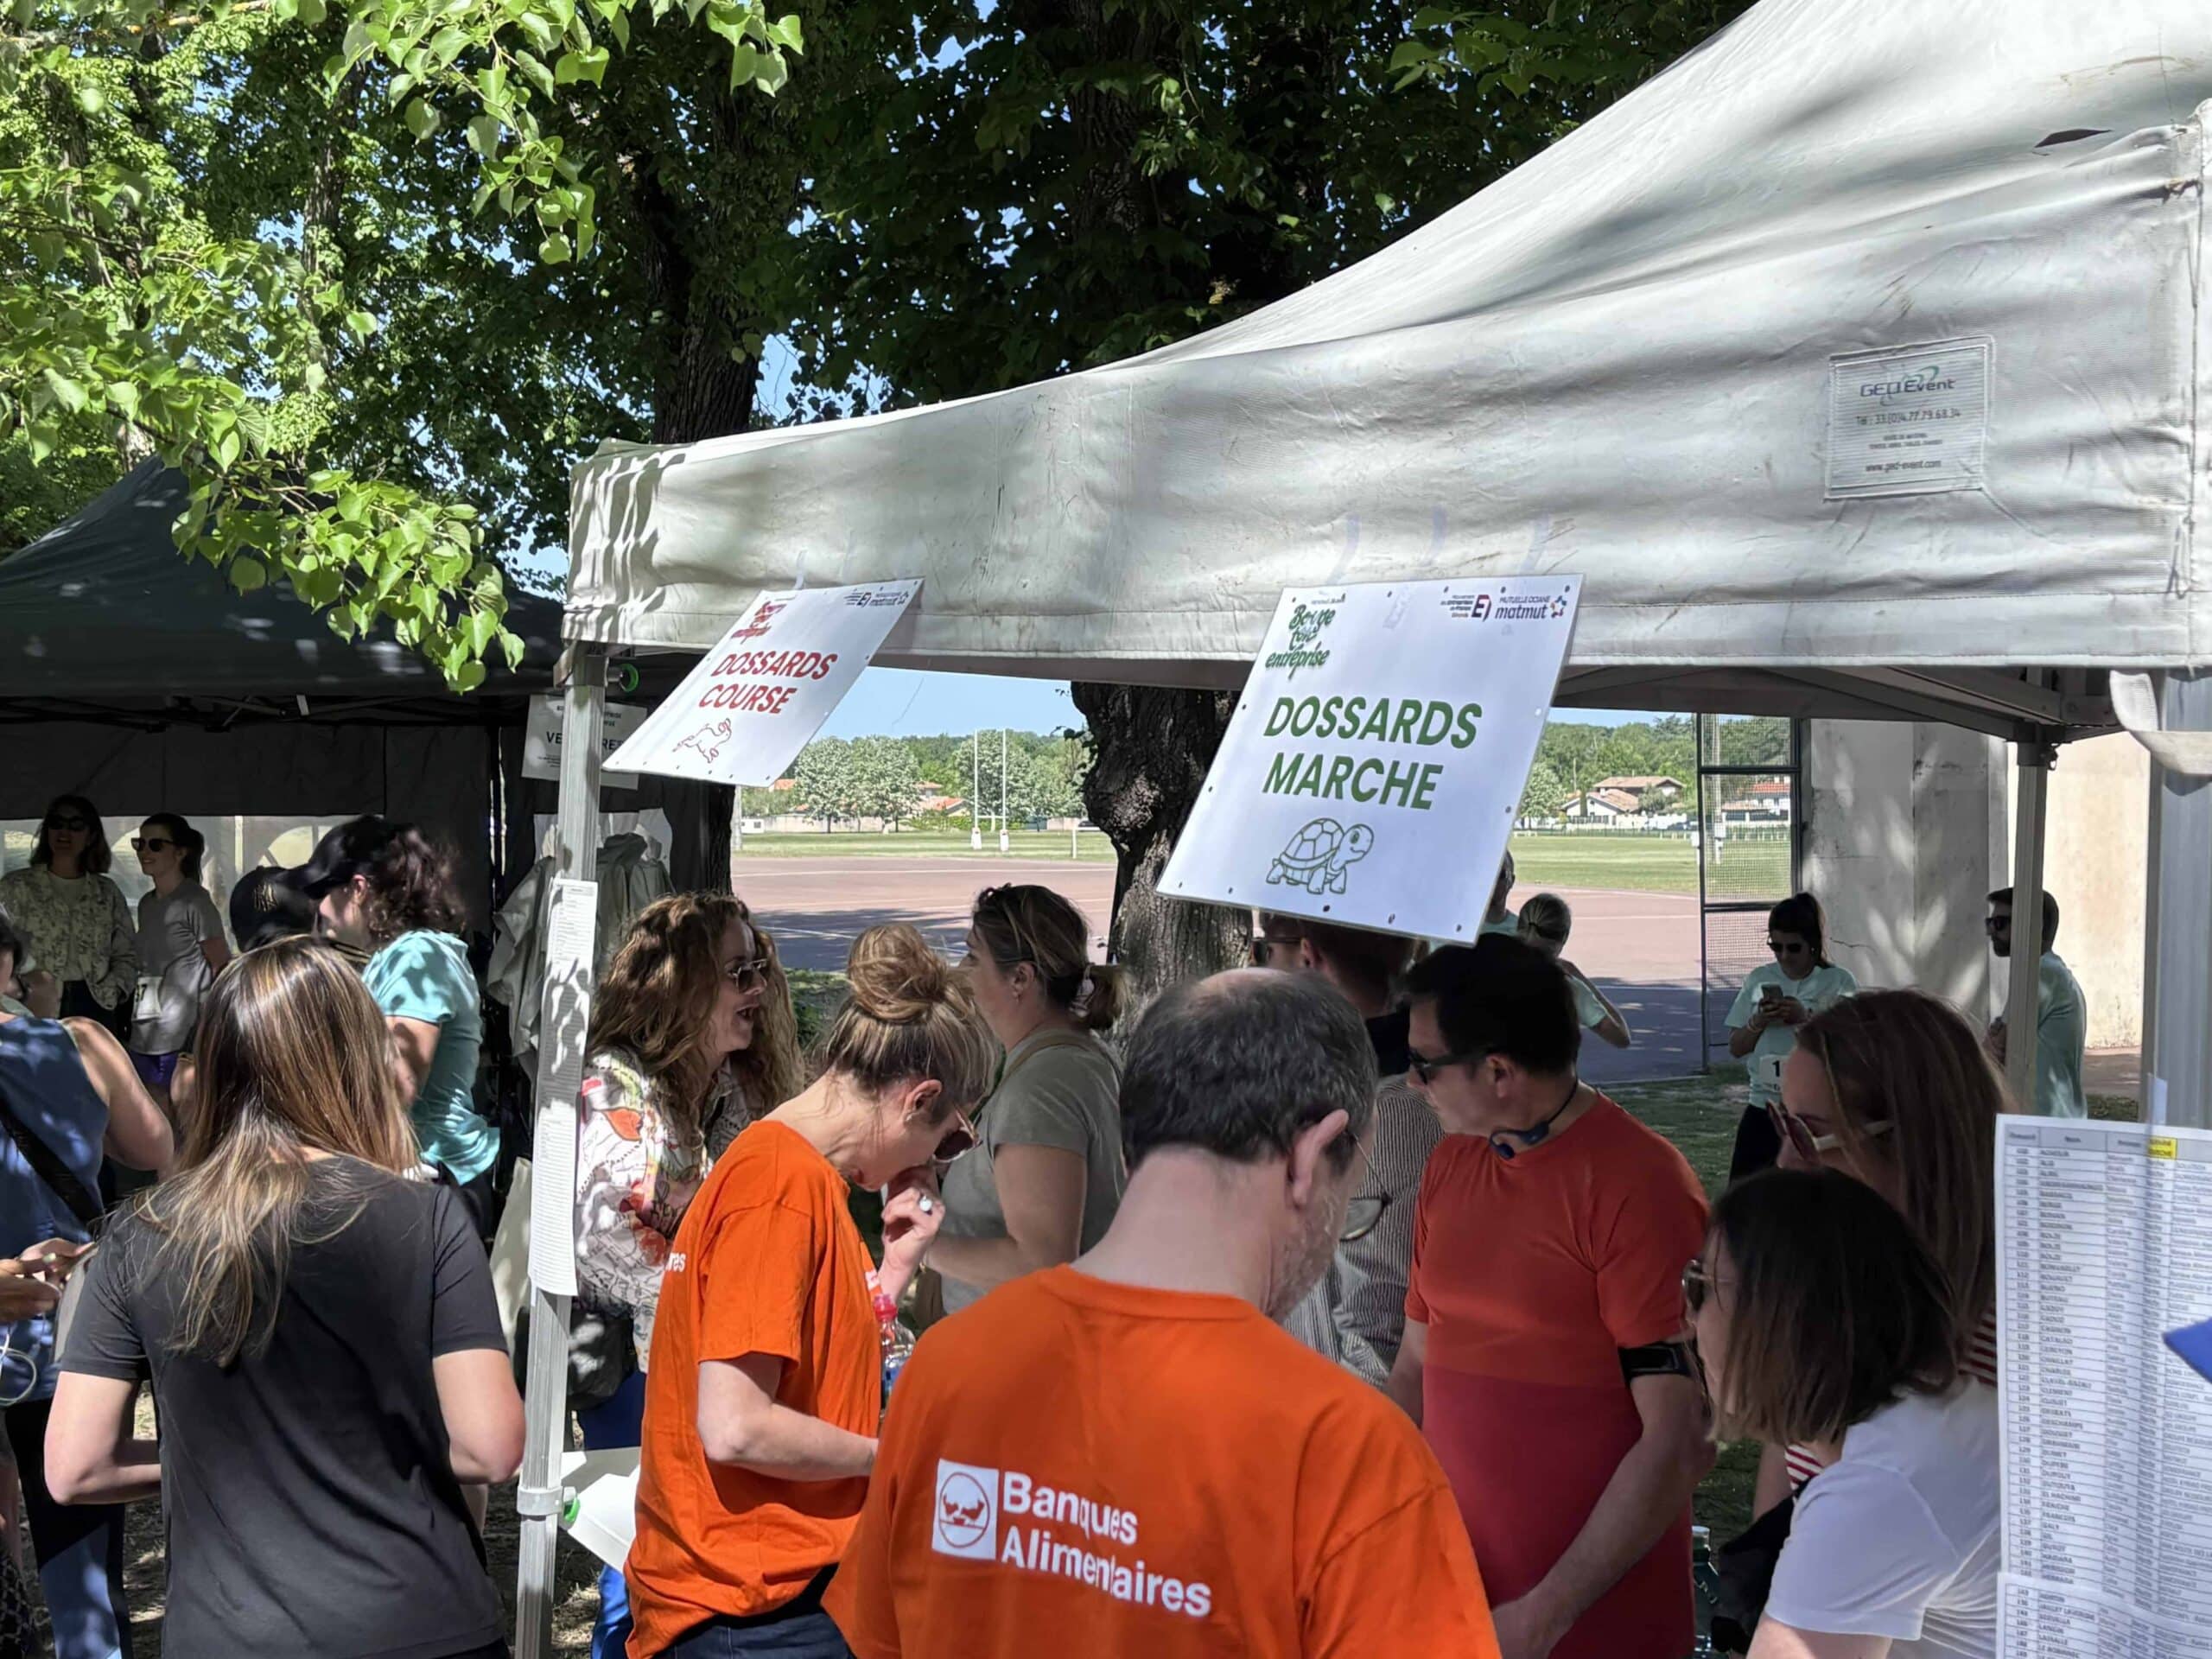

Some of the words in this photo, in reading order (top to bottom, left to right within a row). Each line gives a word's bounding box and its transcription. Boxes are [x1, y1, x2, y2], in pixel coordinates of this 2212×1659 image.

[1495, 605, 1548, 620] matmut
[711, 651, 838, 680] DOSSARDS
[1265, 641, 1330, 680] entreprise
[699, 683, 798, 715] COURSE
[1263, 696, 1482, 749] DOSSARDS
[1262, 753, 1444, 810] MARCHE
[1003, 1471, 1138, 1545] Banques
[1002, 1526, 1211, 1617] Alimentaires
